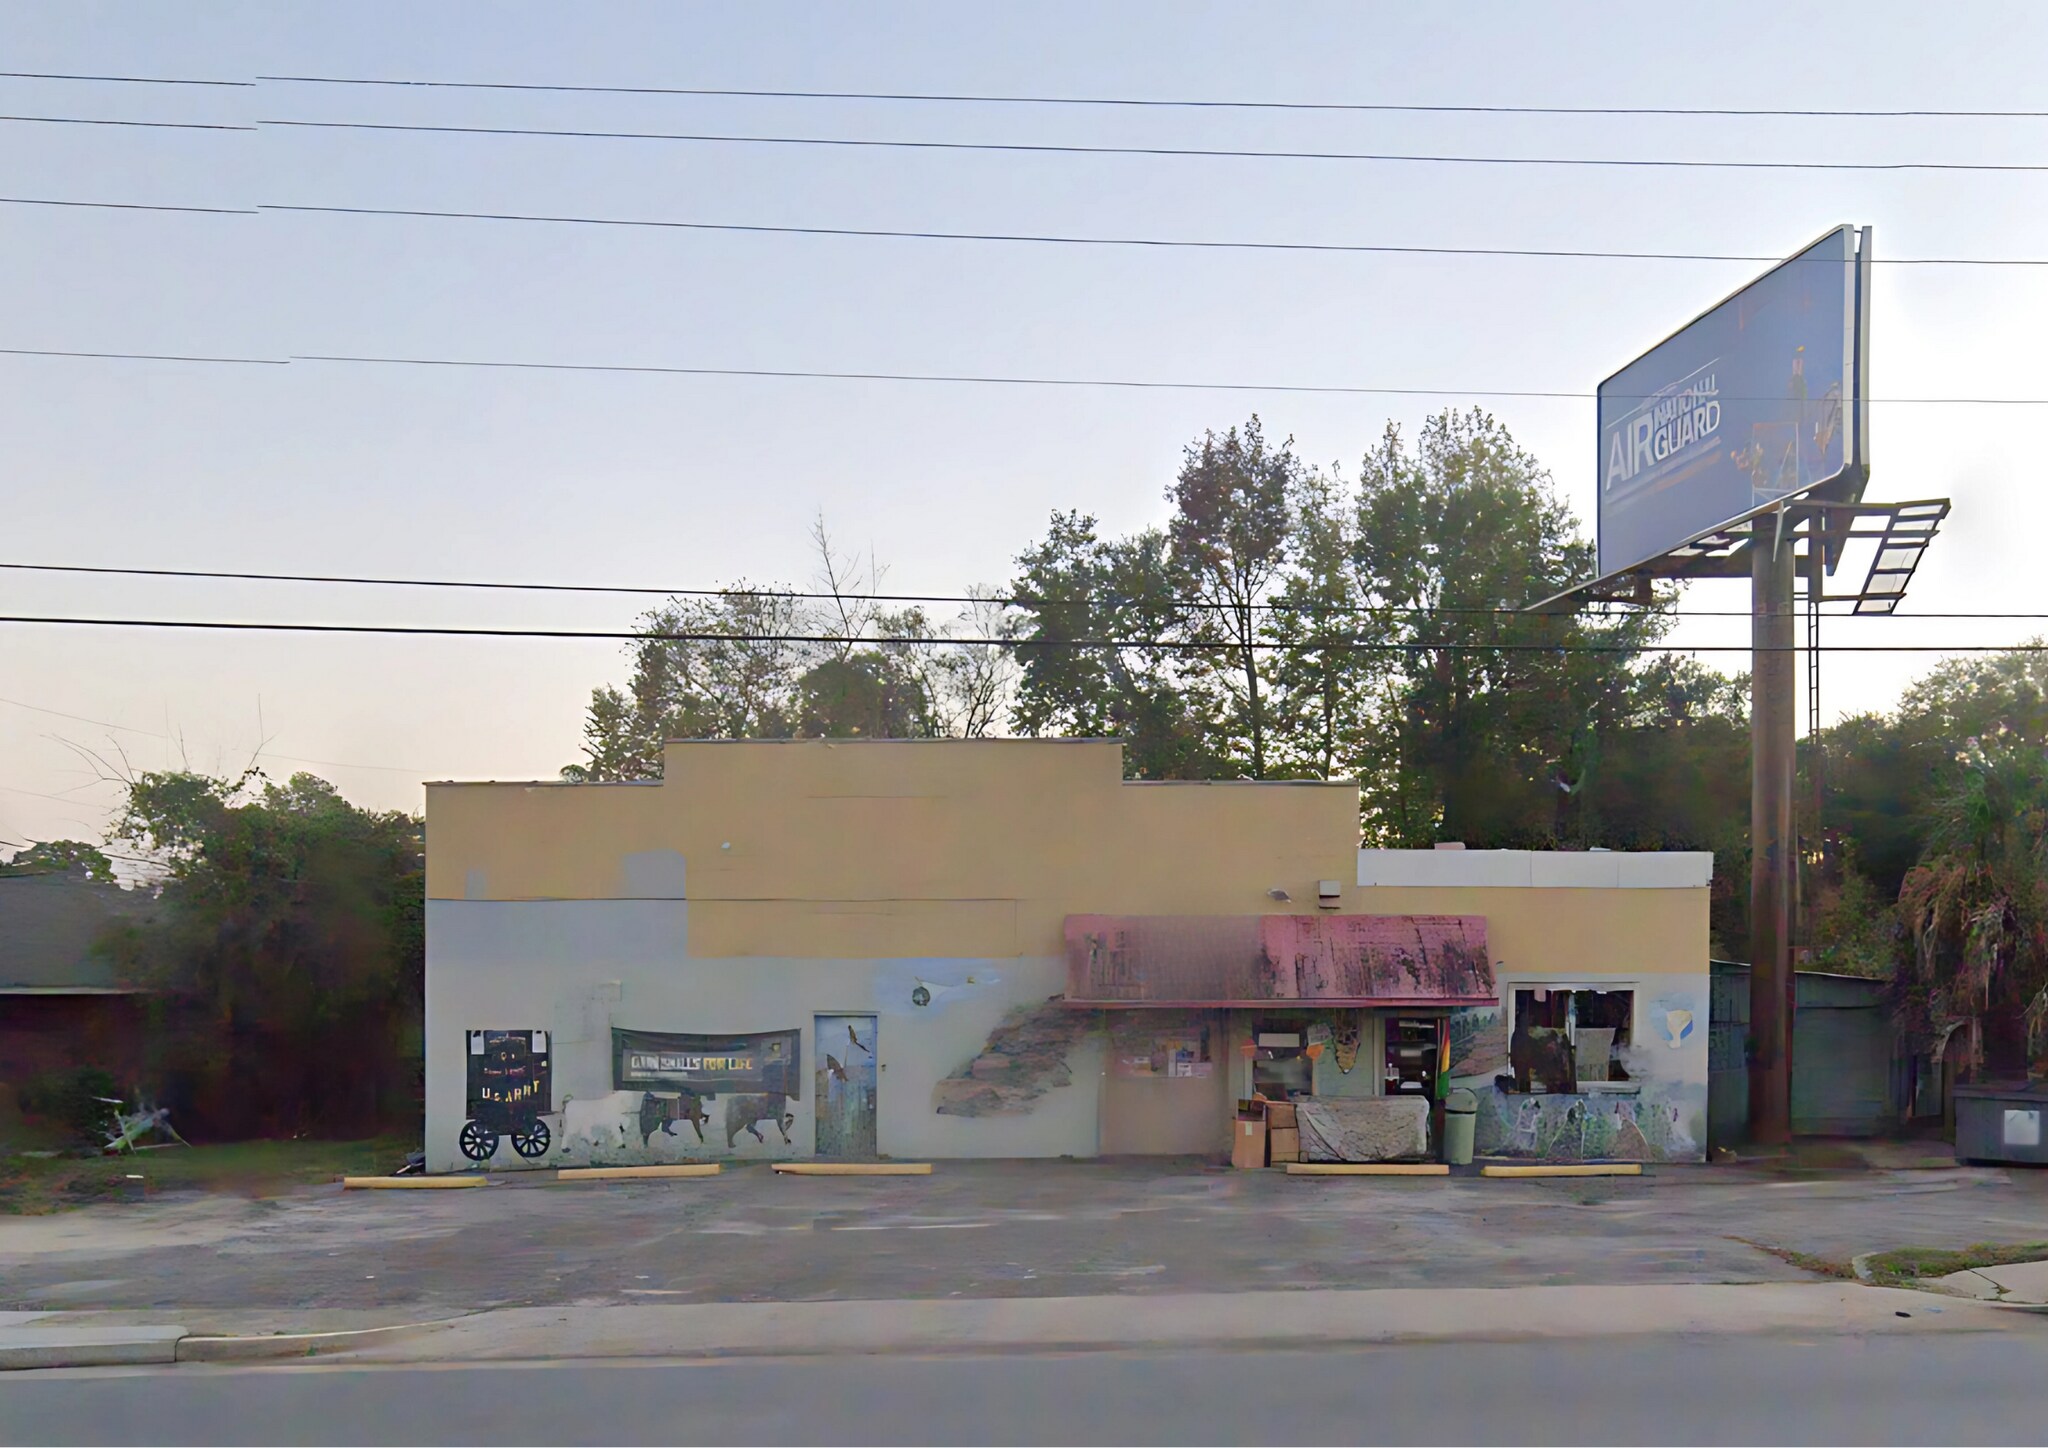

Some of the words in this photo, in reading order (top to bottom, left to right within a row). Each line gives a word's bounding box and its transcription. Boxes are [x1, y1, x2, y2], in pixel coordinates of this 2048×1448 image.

[1605, 411, 1656, 492] AIR
[1654, 400, 1721, 462] GUARD
[703, 1056, 727, 1071] FOR
